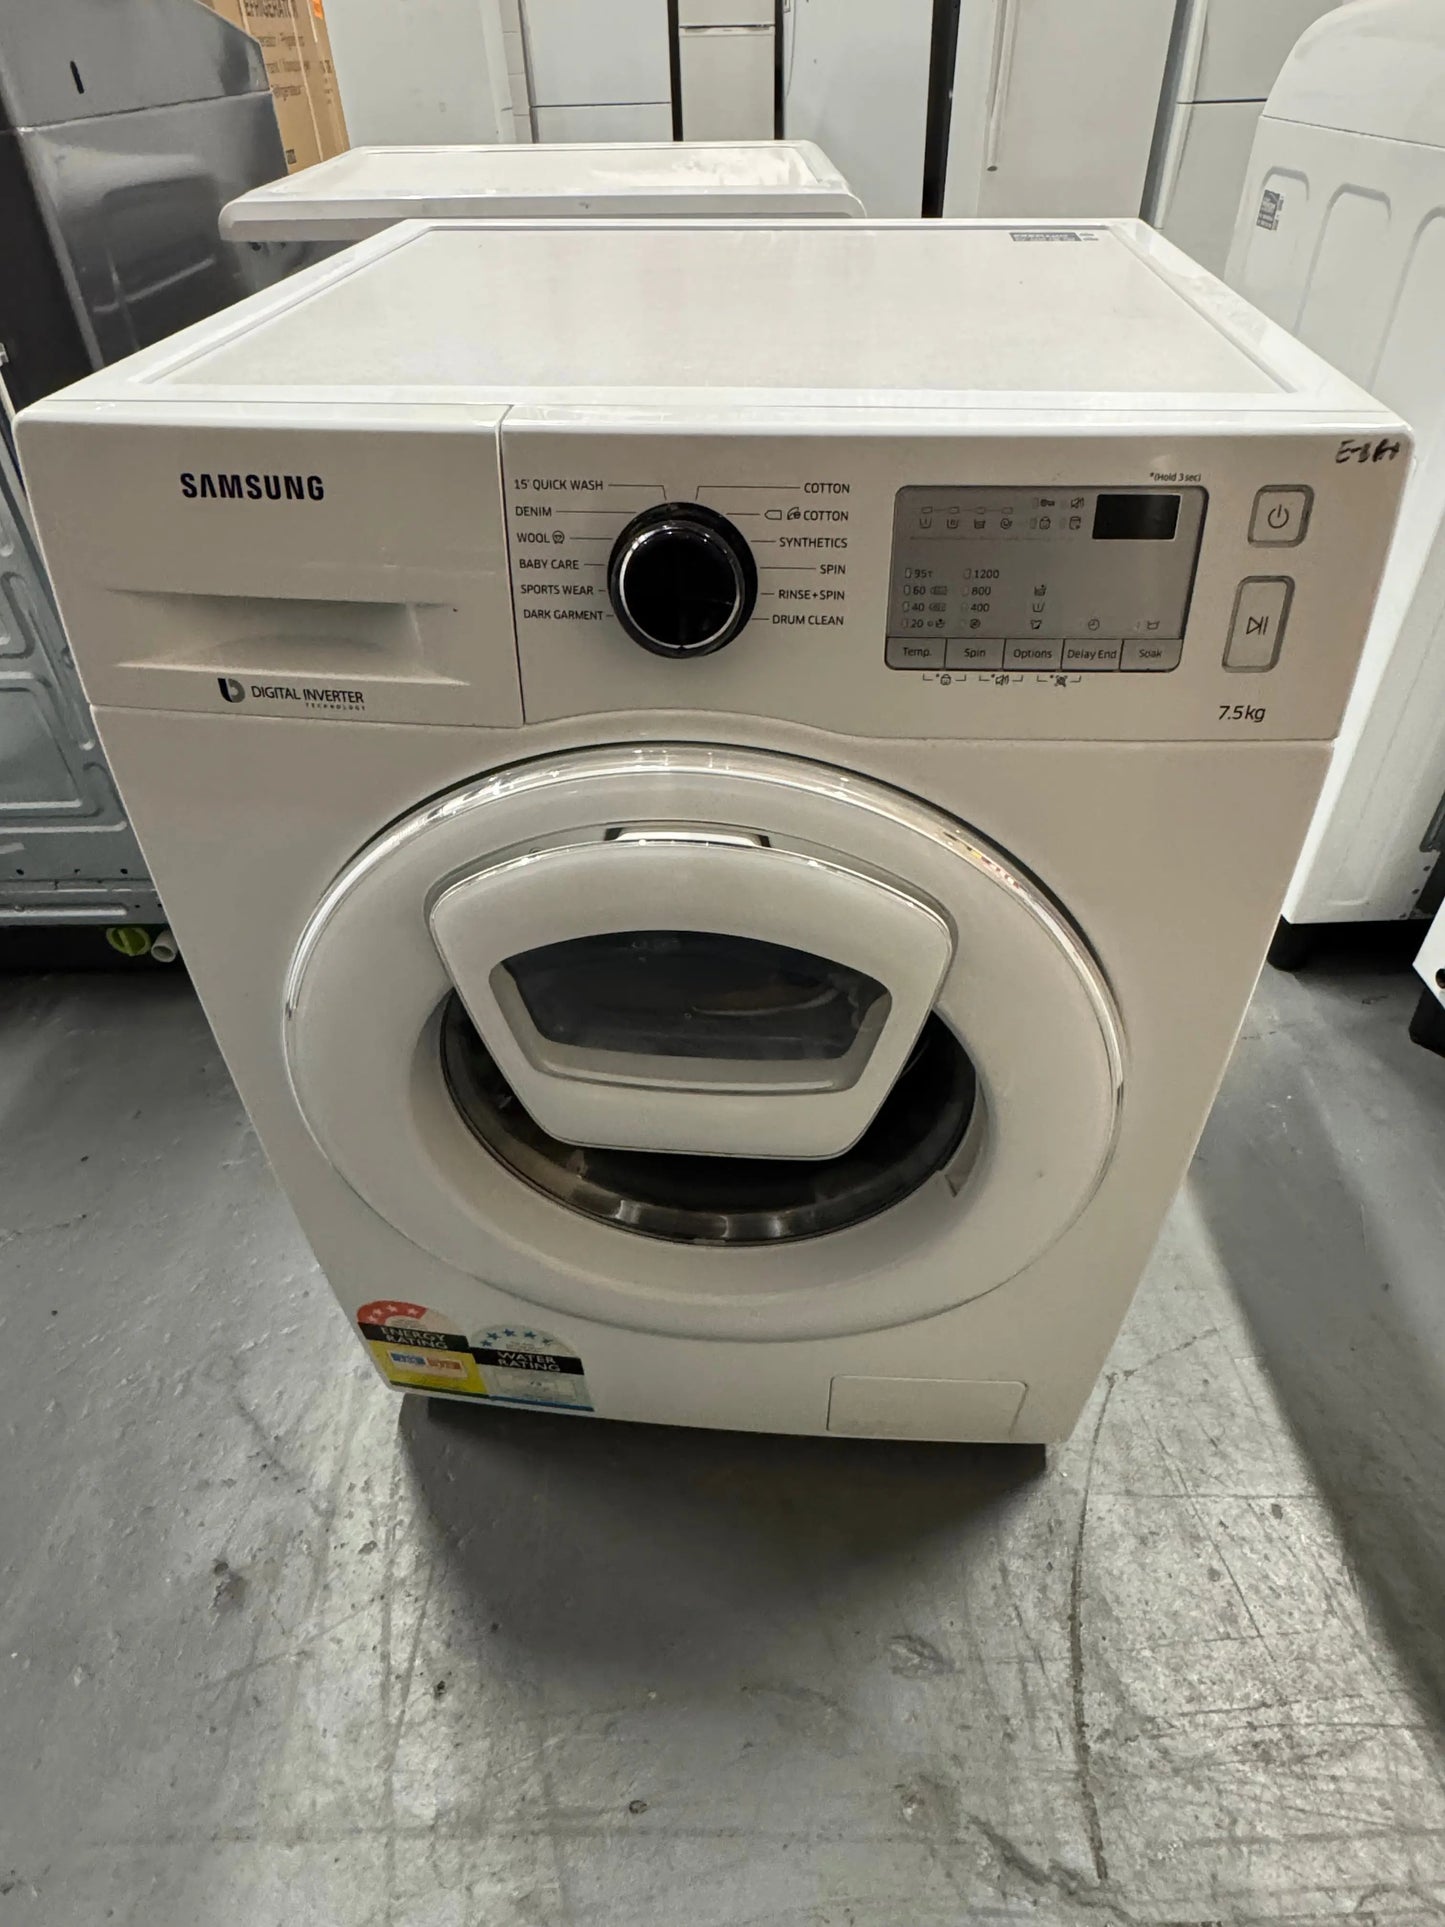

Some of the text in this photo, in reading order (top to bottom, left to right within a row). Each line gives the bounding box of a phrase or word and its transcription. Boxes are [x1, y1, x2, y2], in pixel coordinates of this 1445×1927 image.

[1178, 472, 1185, 482] 3
[180, 472, 325, 500] SAMSUNG
[532, 479, 568, 491] QUICK
[570, 480, 604, 491] WASH
[803, 482, 851, 495] COTTON
[514, 506, 552, 517] DENIM
[803, 510, 849, 522] COTTON
[516, 532, 551, 544] WOOL
[779, 537, 849, 549] SYNTHETICS
[519, 559, 580, 570] BABY CARE
[819, 564, 847, 575] SPIN
[974, 569, 1000, 580] 1200
[520, 584, 594, 596] SPORTS WEAR
[912, 585, 926, 596] 60
[971, 586, 992, 597] 800
[911, 602, 926, 613] 40
[970, 602, 990, 613] 400
[523, 609, 604, 621] DARK GARMENT
[772, 614, 846, 626] DRUM CLEAN
[911, 619, 924, 629] 20
[902, 647, 933, 658] Temp.
[964, 648, 987, 658] Spin
[1013, 649, 1053, 660] Options
[1067, 649, 1118, 660] Delay End
[1138, 648, 1163, 659] Soak
[251, 685, 365, 703] DIGITAL INVERTER
[380, 1327, 447, 1342] ENERGY
[385, 1334, 448, 1349] RATING
[497, 1351, 556, 1364] WATER
[497, 1359, 561, 1372] RATING
